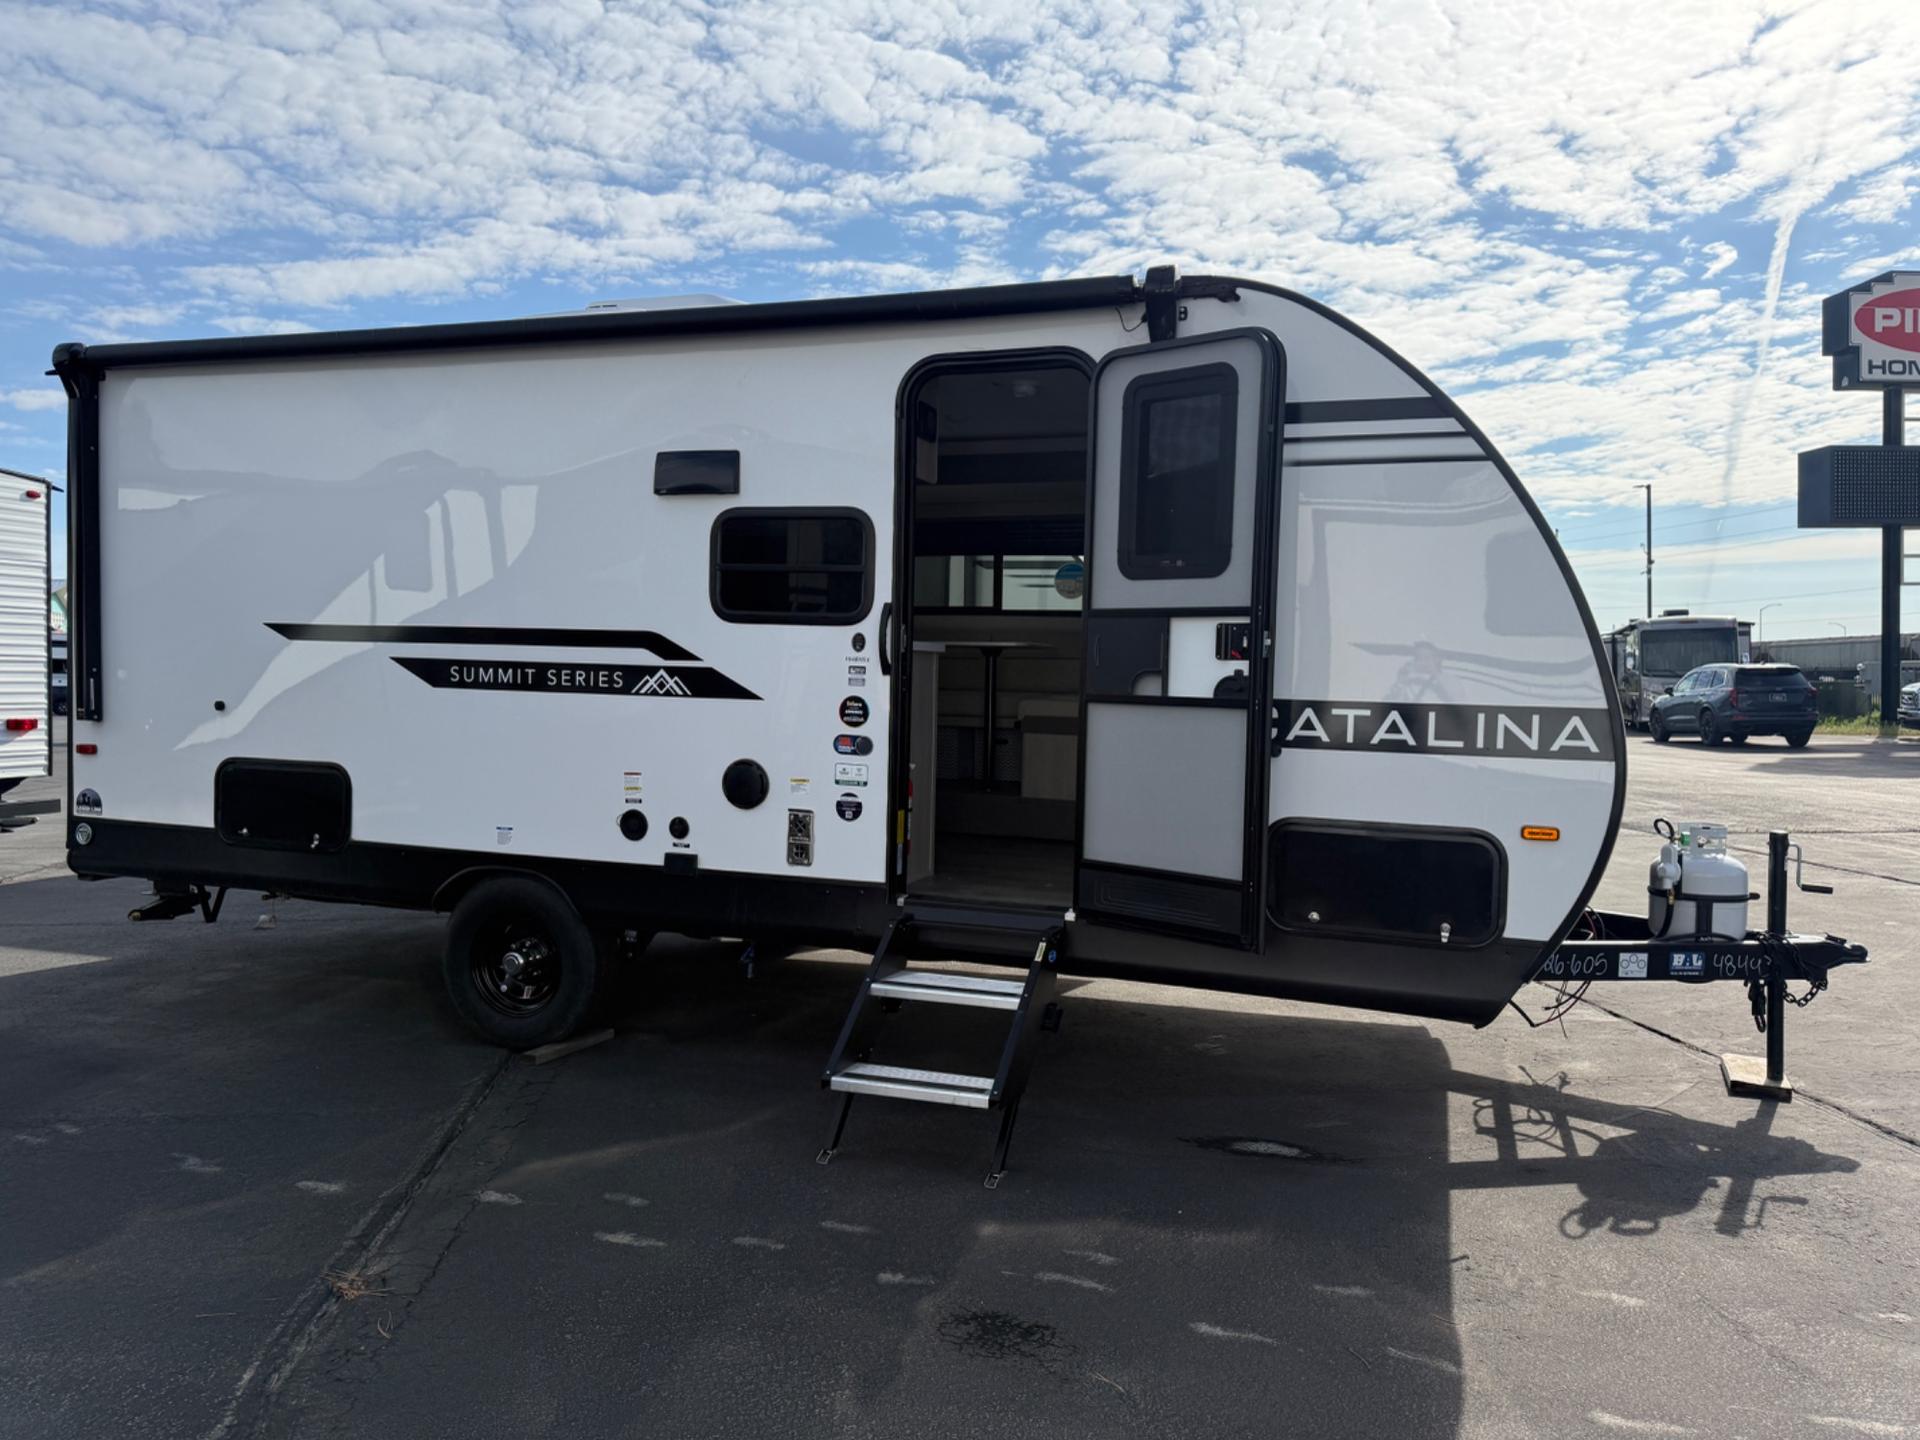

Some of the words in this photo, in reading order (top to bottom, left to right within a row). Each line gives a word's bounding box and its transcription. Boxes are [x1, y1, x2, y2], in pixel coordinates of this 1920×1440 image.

[1874, 308, 1920, 333] PI
[449, 665, 536, 685] SUMMIT
[547, 668, 624, 689] SERIES
[1271, 706, 1600, 753] ATALINA
